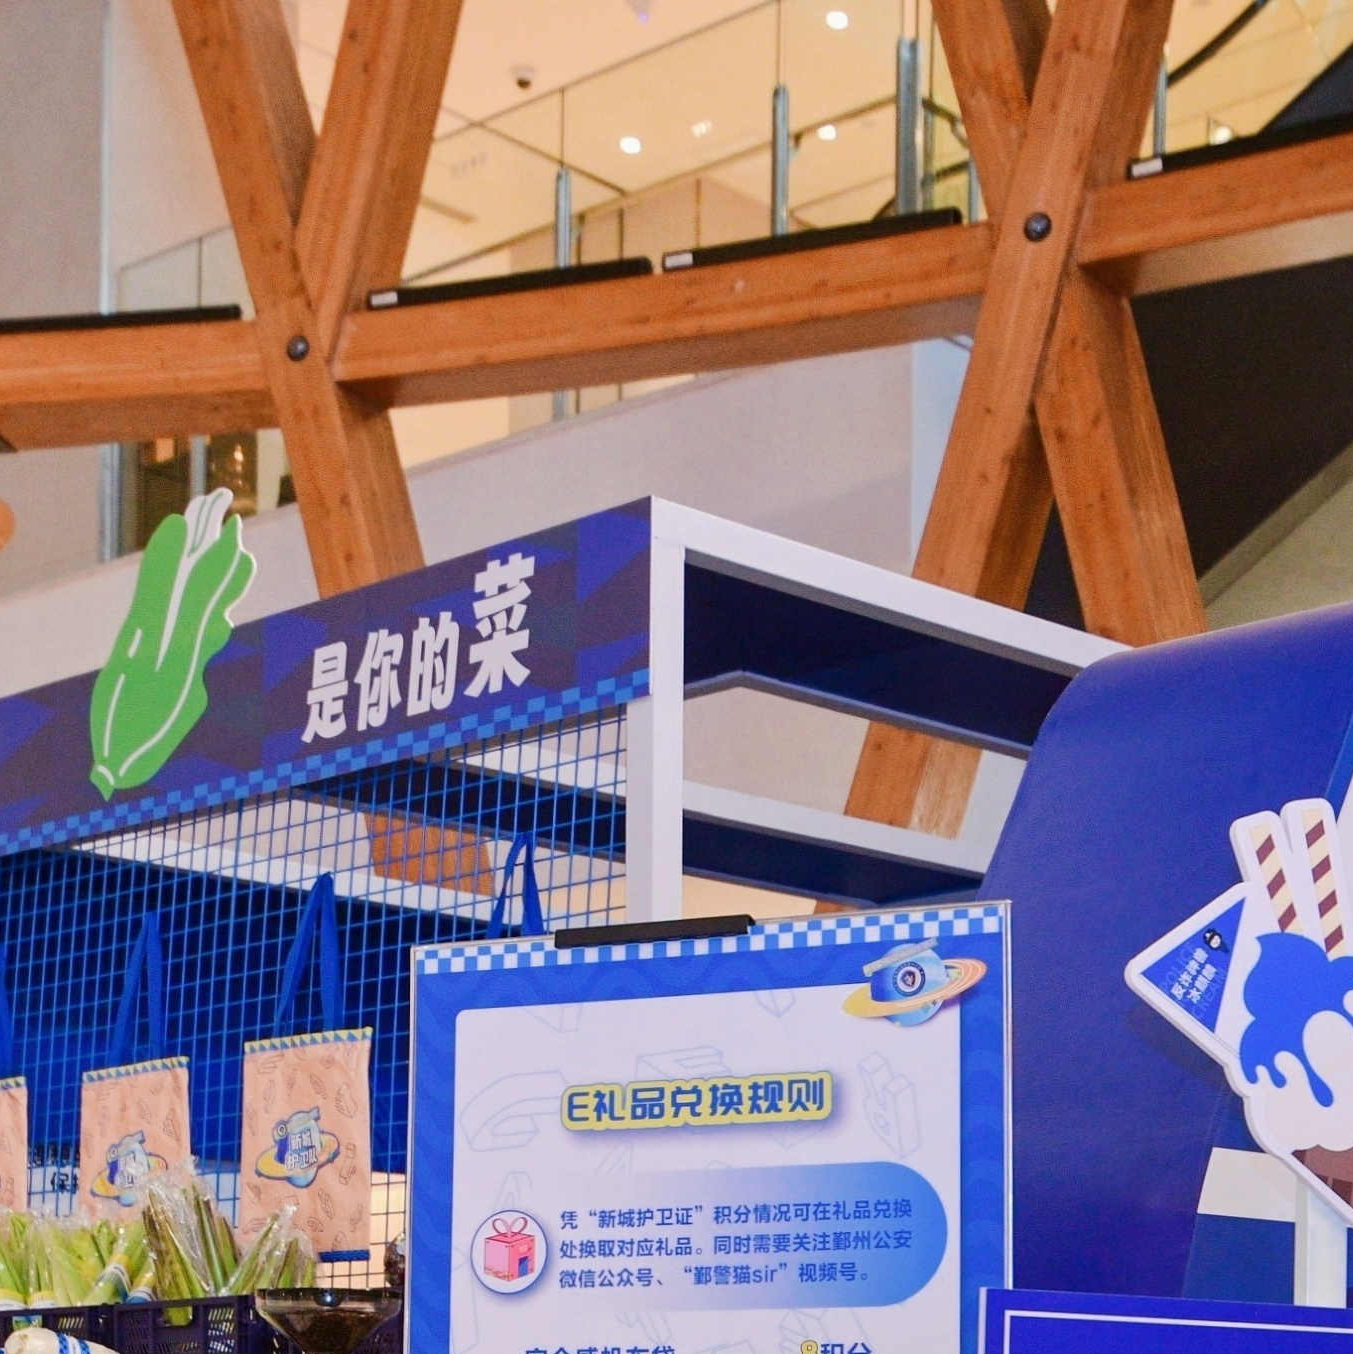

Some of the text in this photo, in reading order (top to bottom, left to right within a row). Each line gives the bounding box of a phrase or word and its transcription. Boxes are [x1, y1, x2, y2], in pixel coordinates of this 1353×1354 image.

[301, 552, 535, 746] 是你的菜
[567, 1077, 825, 1123] E礼品兑换规则
[560, 1230, 913, 1258] 处换取对应礼品。同时需要关注鄞州公安
